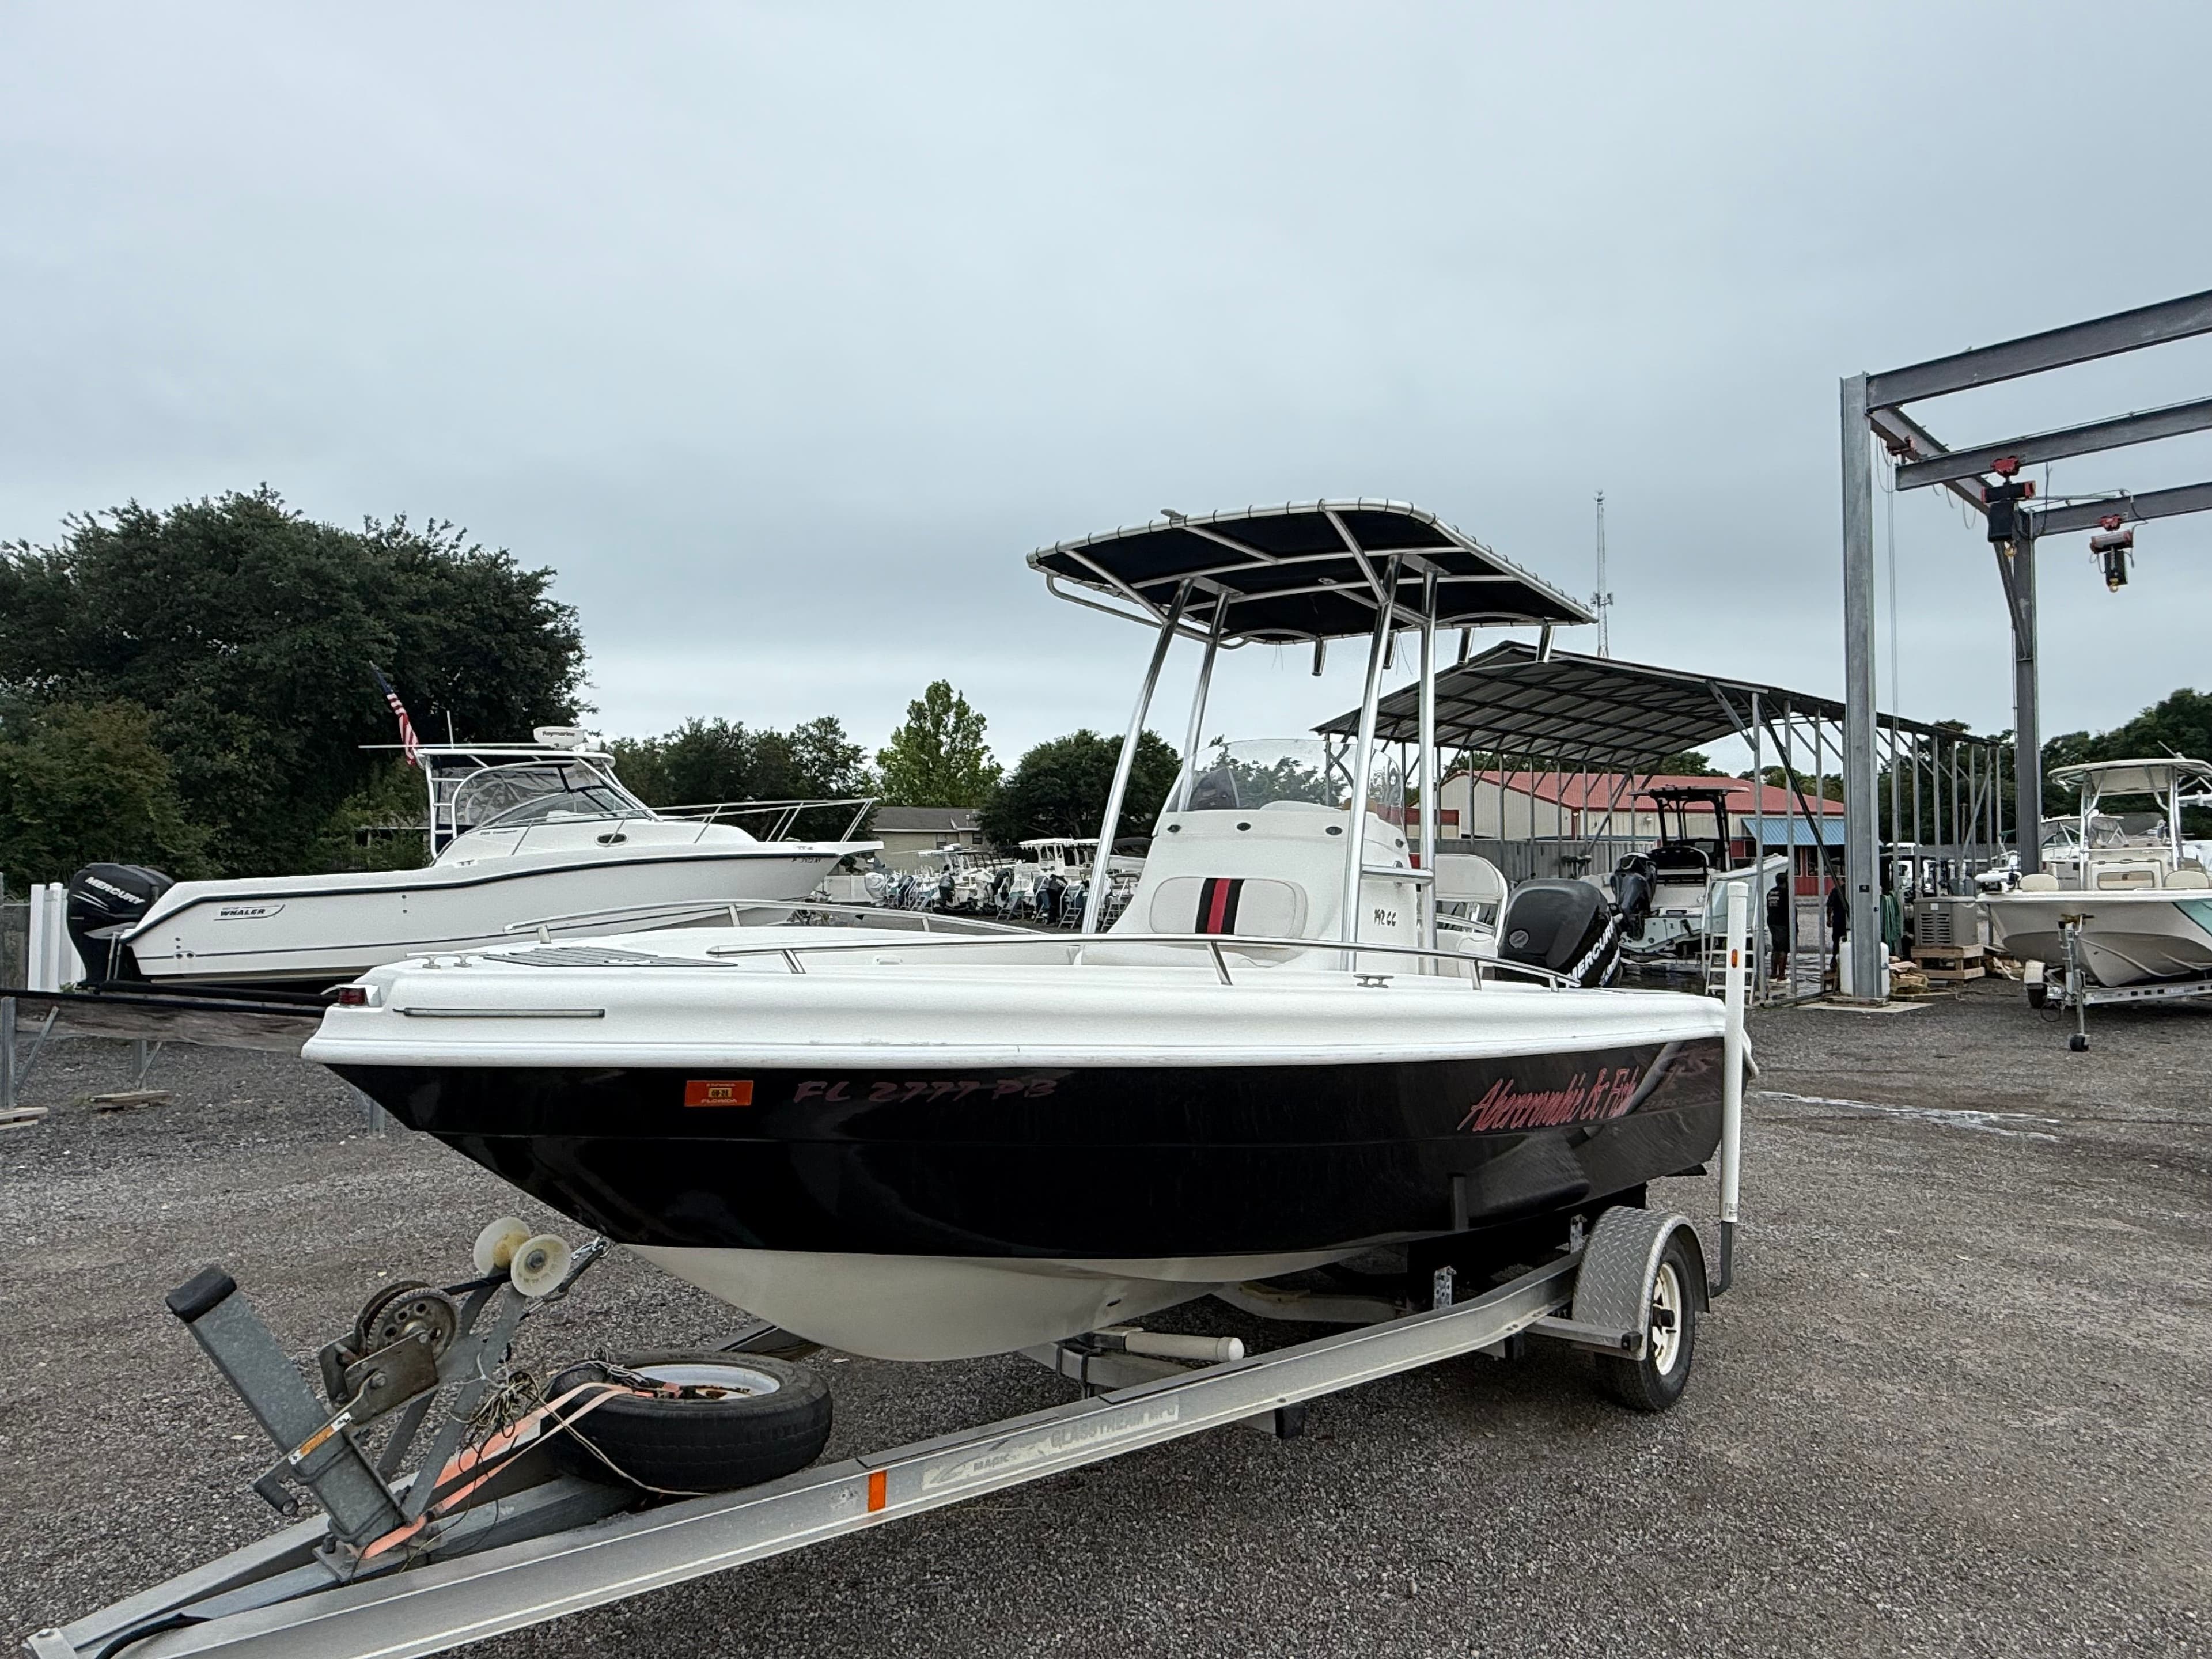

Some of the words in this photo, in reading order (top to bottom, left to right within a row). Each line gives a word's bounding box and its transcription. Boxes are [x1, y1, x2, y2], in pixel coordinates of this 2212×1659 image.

[85, 876, 145, 904] MERCURY
[221, 908, 266, 916] WHALER
[793, 1081, 851, 1103] FL
[868, 1081, 980, 1103] 2777
[991, 1078, 1058, 1100] PB
